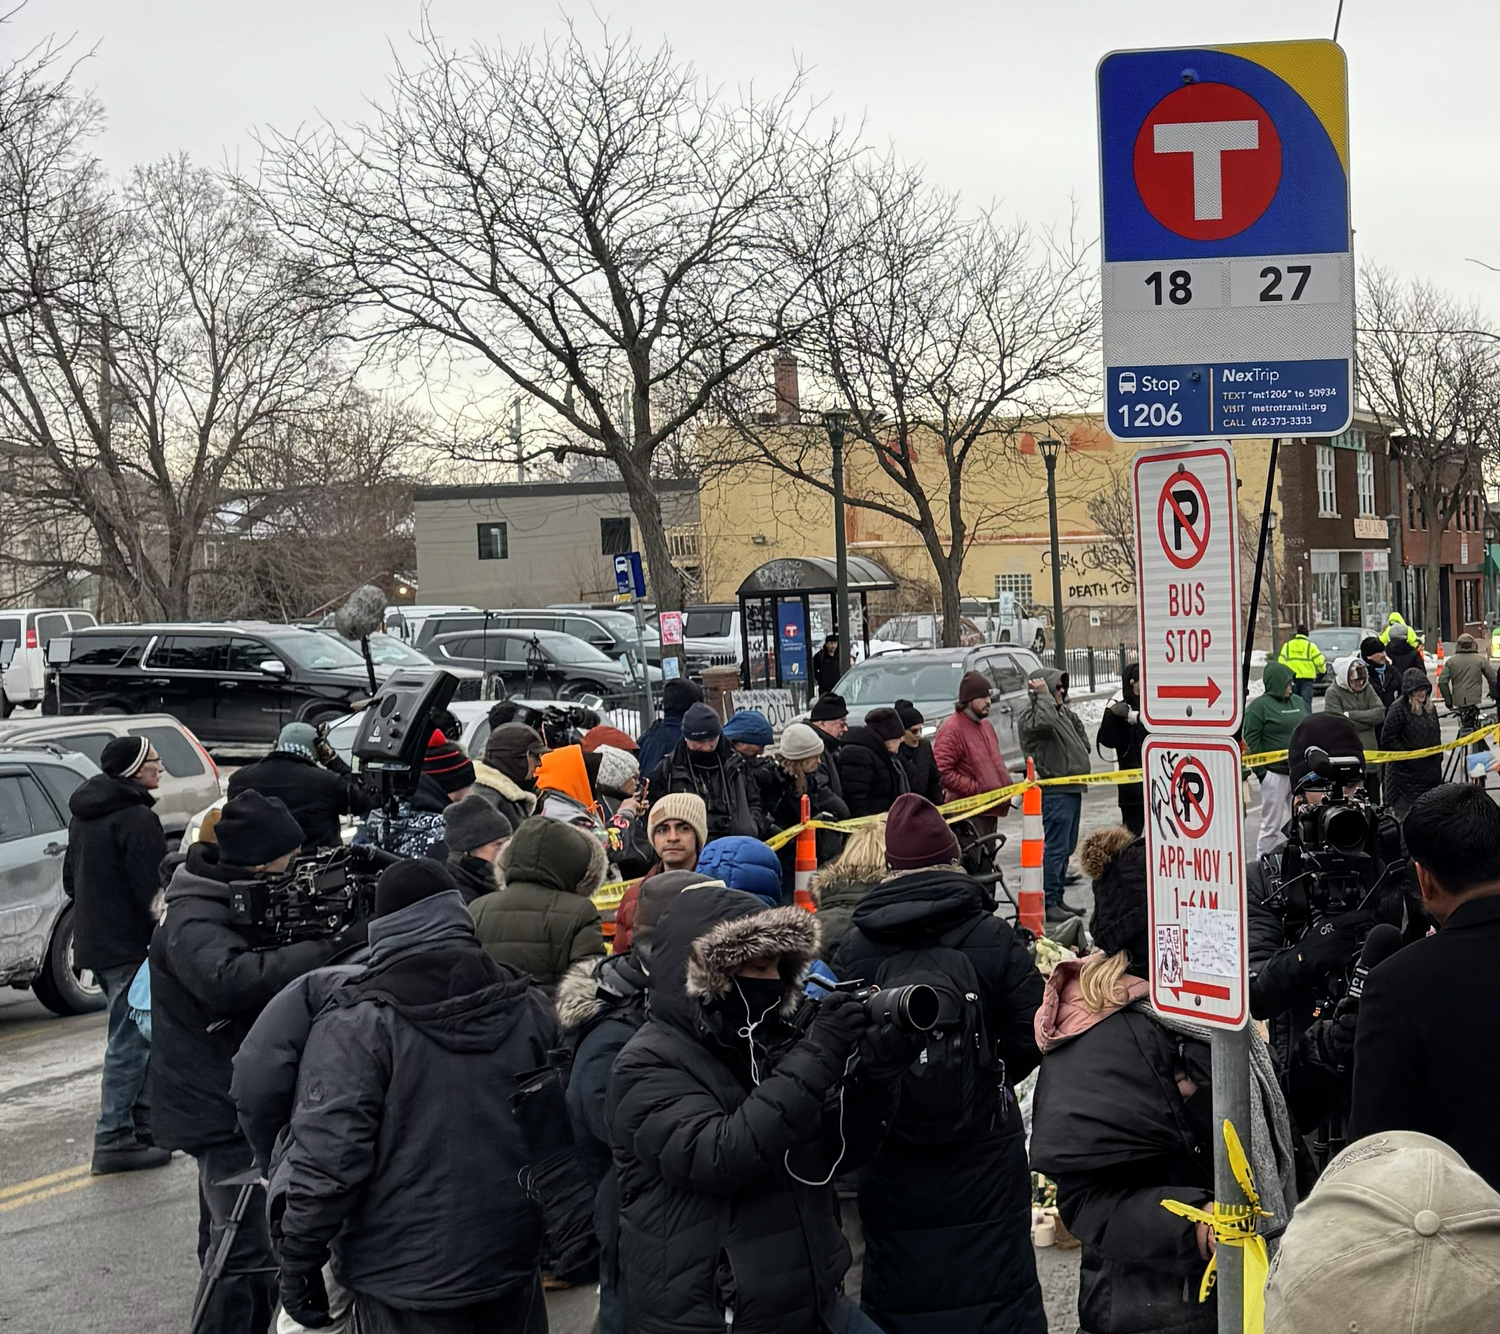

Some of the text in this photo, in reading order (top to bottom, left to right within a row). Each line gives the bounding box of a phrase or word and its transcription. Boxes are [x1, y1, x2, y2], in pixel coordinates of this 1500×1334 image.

[1153, 119, 1259, 221] T
[1144, 265, 1312, 306] 18 27
[1141, 375, 1180, 396] Stop
[1222, 368, 1280, 385] NexTrip
[1222, 391, 1246, 400] TEXT
[1295, 390, 1305, 398] to
[1308, 387, 1337, 398] 50934
[1118, 402, 1183, 428] 1206
[1222, 402, 1327, 413] VISIT metrotransit.org
[1222, 416, 1313, 427] CALL 612-373-3333
[1069, 580, 1130, 598] DEATH TO
[1168, 582, 1205, 617] BUS
[1165, 628, 1211, 663] STOP
[767, 703, 796, 727] OUT
[1151, 750, 1179, 841] FUCK
[1159, 845, 1234, 885] APR-NOV 1
